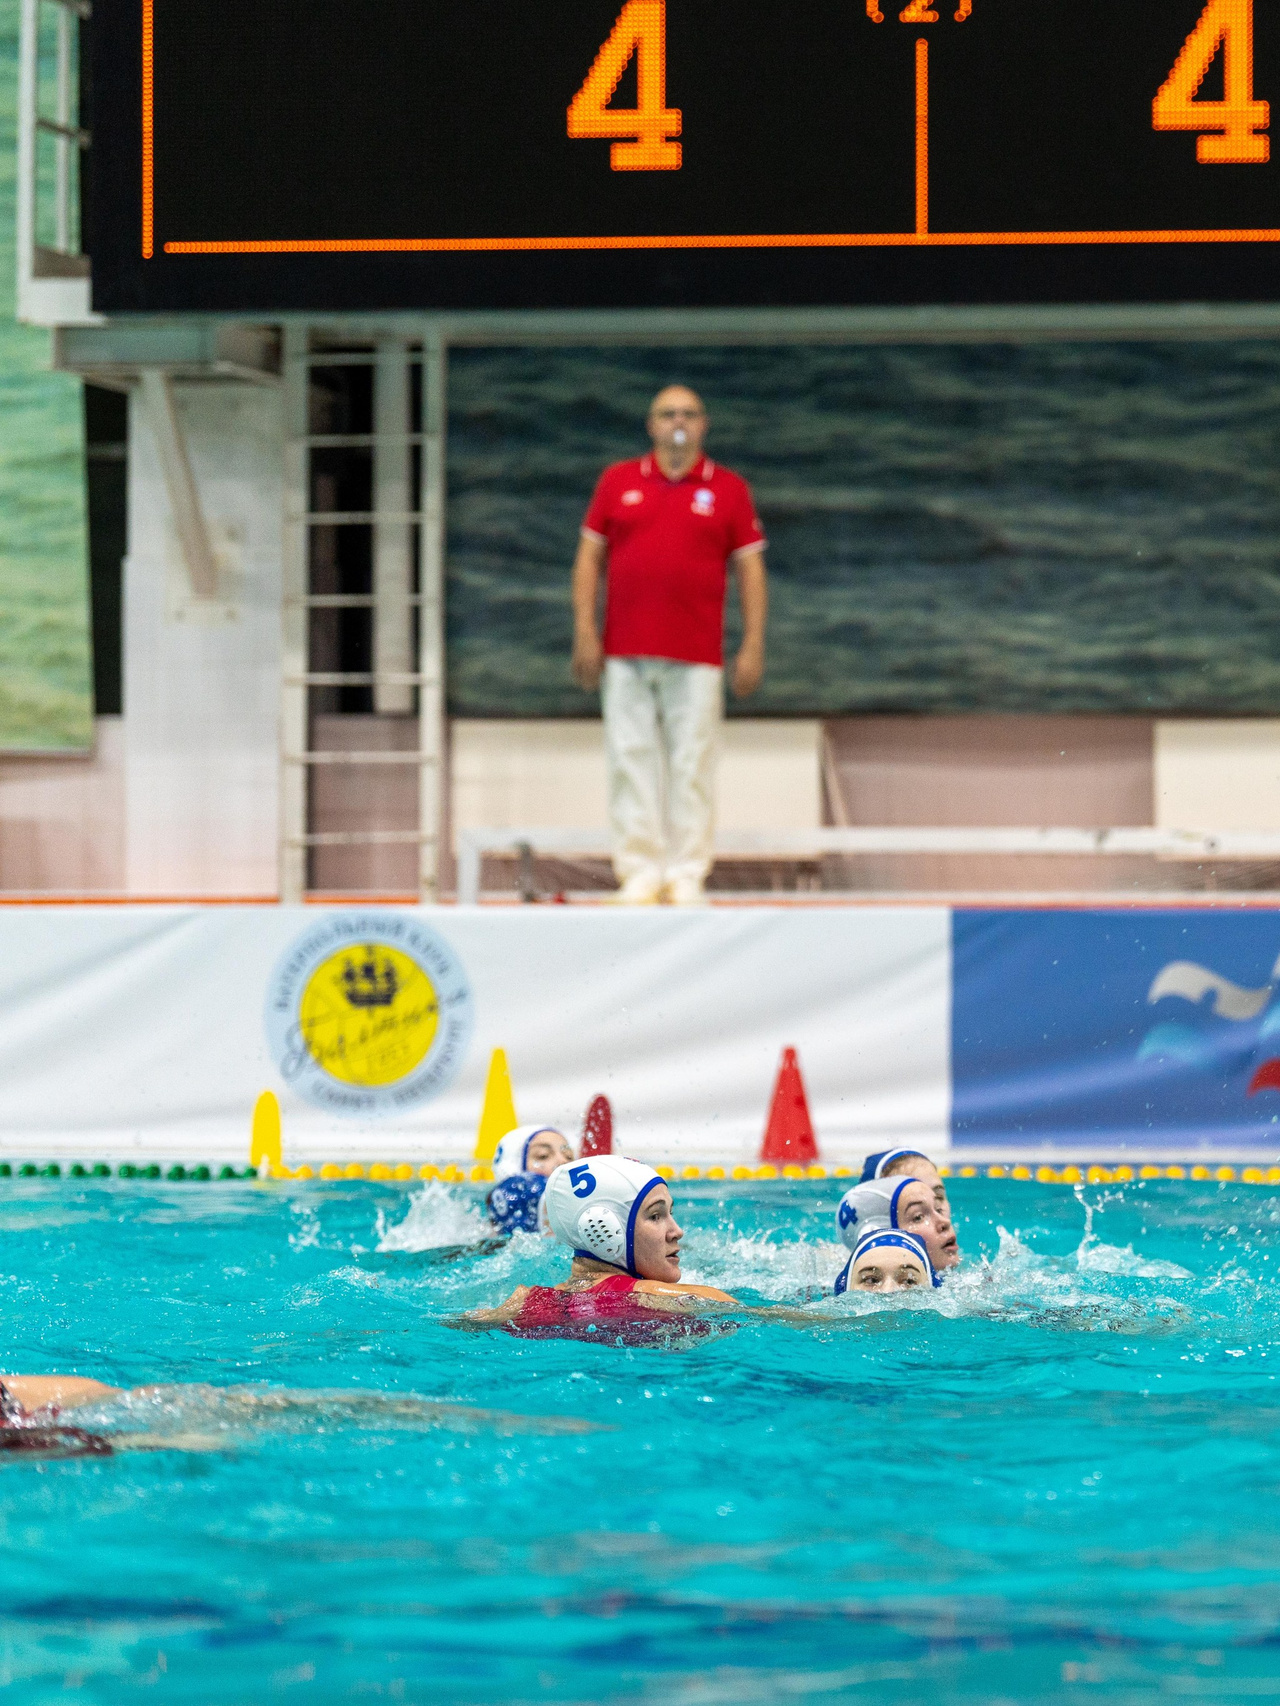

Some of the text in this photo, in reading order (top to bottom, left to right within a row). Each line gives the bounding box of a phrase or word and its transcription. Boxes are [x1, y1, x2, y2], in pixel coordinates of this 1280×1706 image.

[566, 0, 682, 171] 4
[1152, 0, 1271, 164] 4
[568, 1163, 597, 1199] 5
[838, 1200, 858, 1230] 4
